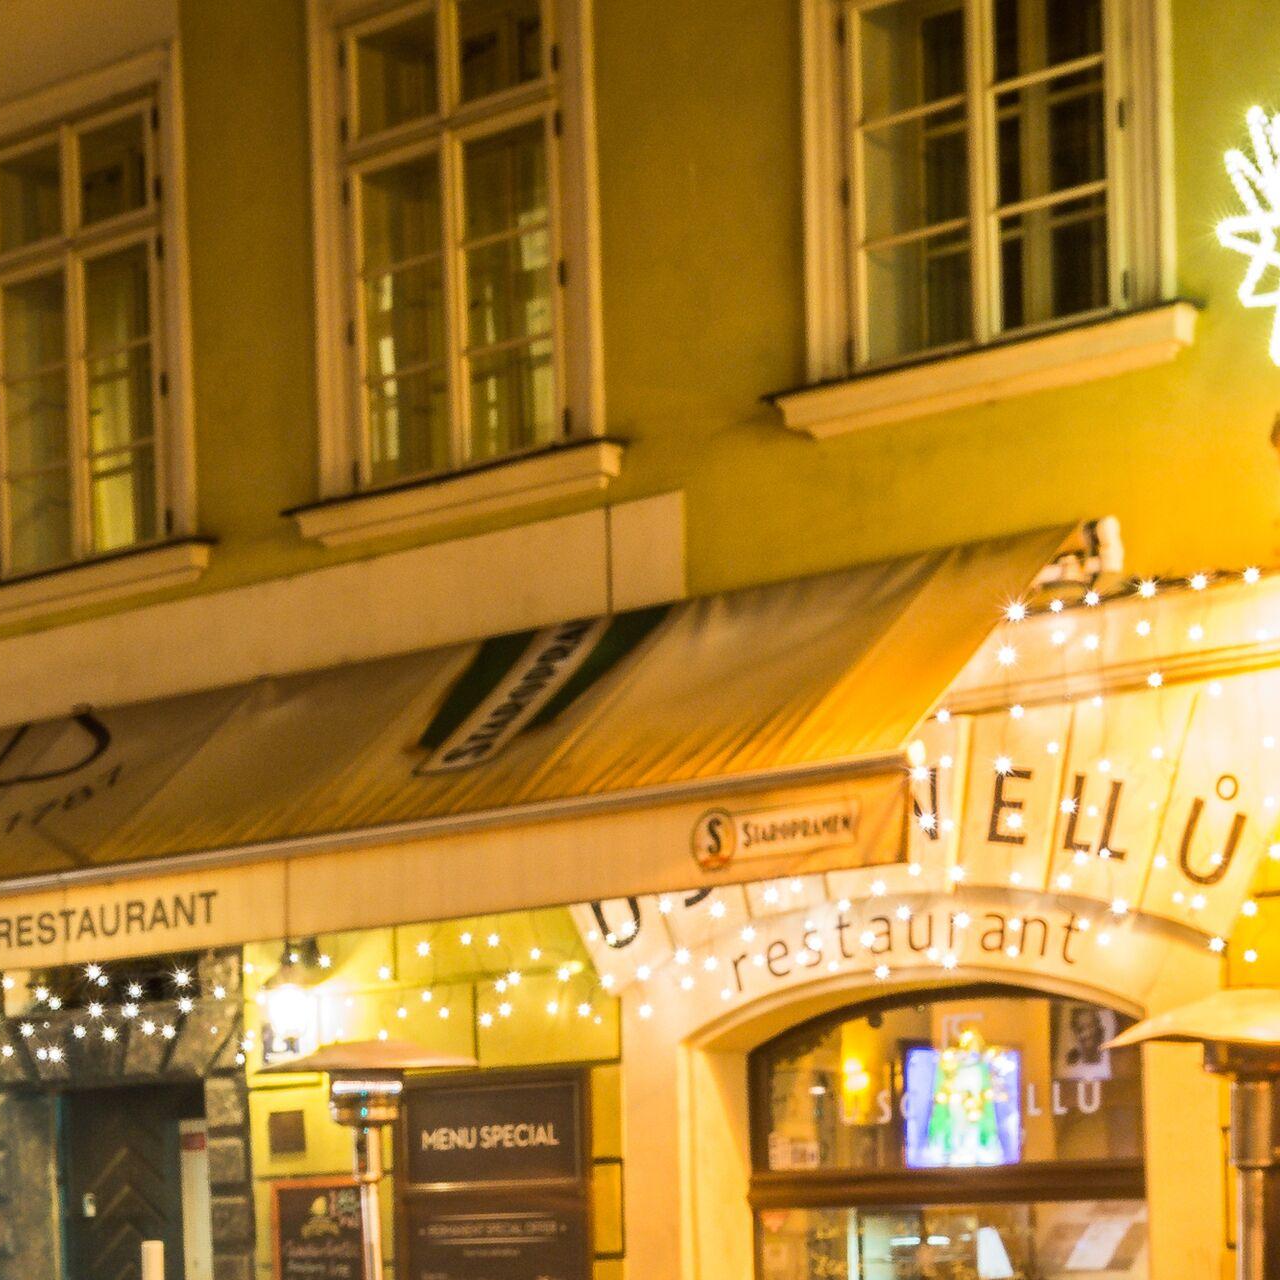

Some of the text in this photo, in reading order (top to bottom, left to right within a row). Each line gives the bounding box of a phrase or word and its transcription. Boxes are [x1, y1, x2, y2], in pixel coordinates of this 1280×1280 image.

[731, 908, 1082, 993] restaurant
[421, 1121, 561, 1152] MENU SPECIAL
